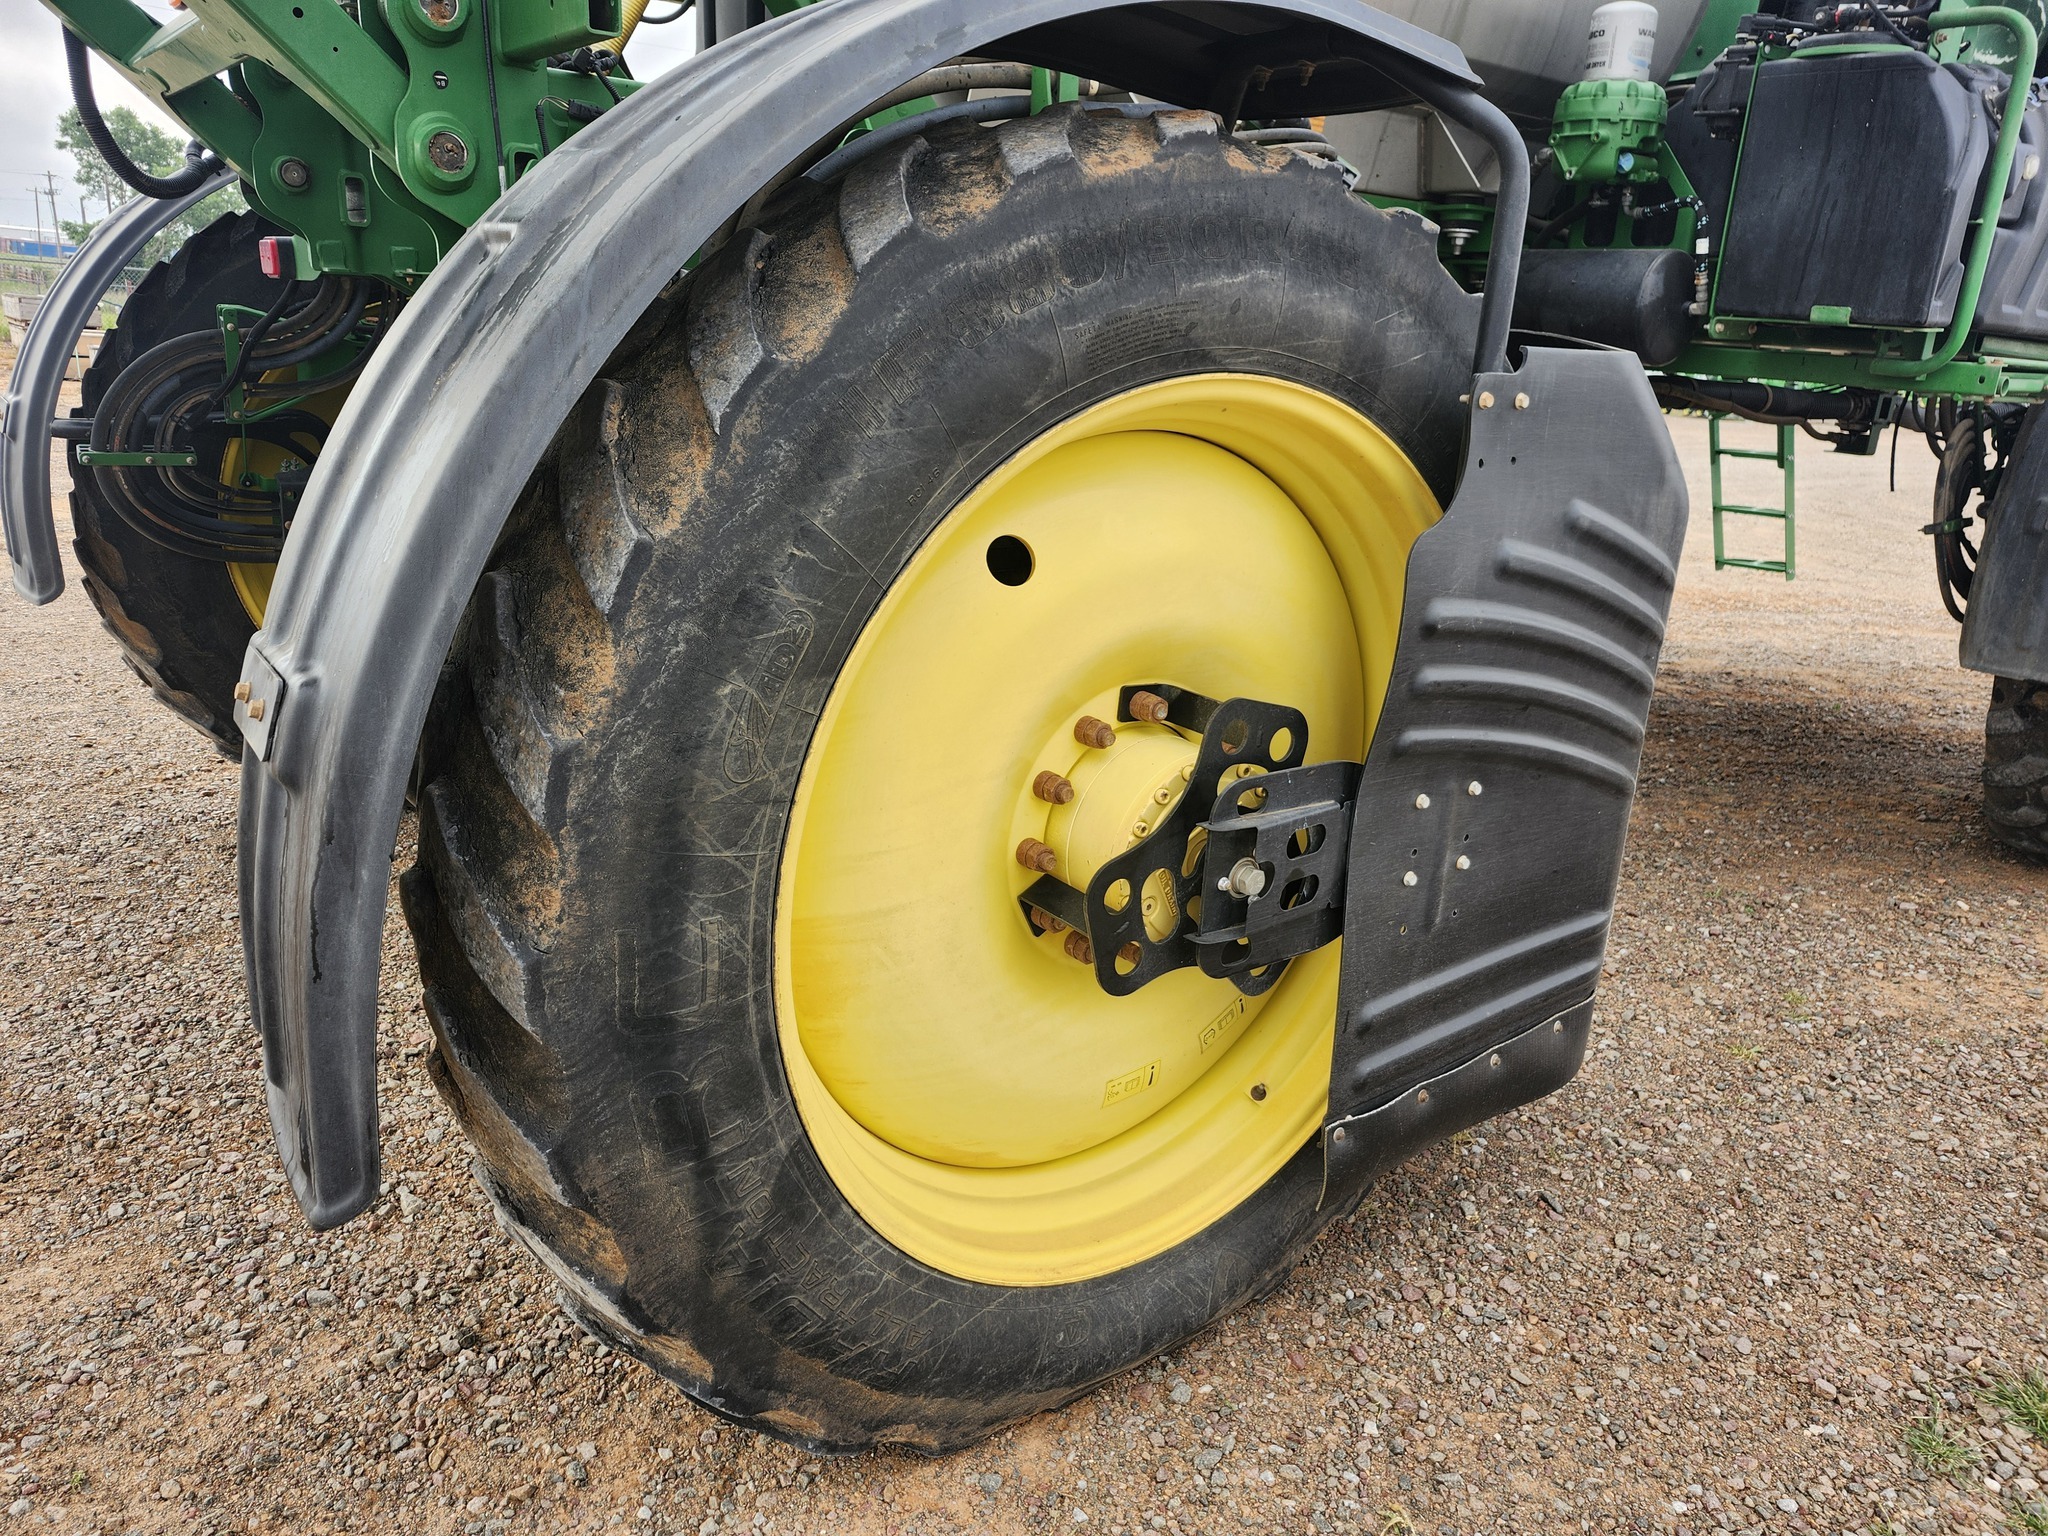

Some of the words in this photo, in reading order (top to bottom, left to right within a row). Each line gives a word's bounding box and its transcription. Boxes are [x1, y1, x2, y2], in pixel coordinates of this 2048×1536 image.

[1105, 311, 1133, 327] WARNING
[727, 1157, 868, 1326] TRACTION
[871, 1307, 933, 1350] ALL
